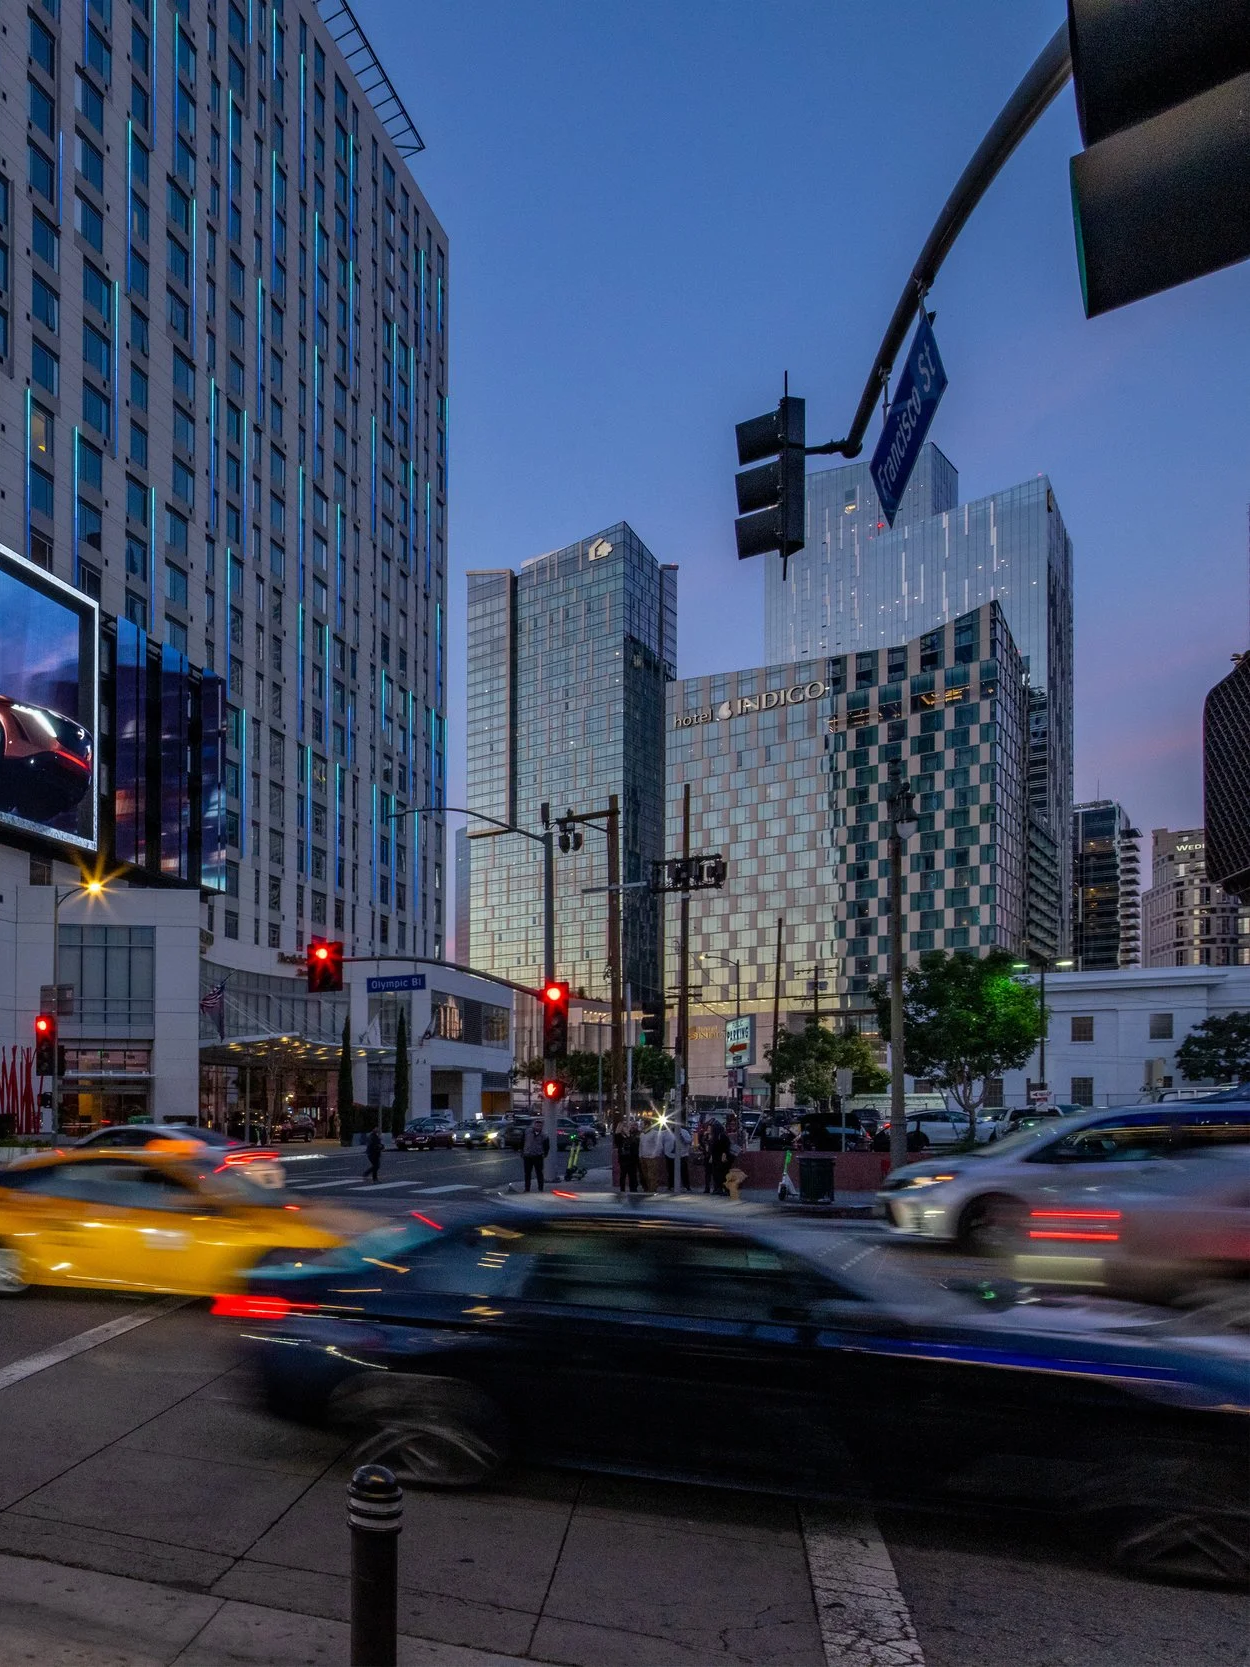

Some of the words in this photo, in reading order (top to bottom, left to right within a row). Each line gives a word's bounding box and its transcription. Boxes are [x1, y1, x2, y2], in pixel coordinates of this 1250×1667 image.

[877, 386, 922, 501] Francisco
[917, 341, 936, 392] St
[673, 708, 714, 728] hotel
[737, 681, 826, 716] INDIGO
[371, 979, 408, 992] Olympic
[411, 977, 422, 987] Bl
[727, 1027, 749, 1041] PARKING
